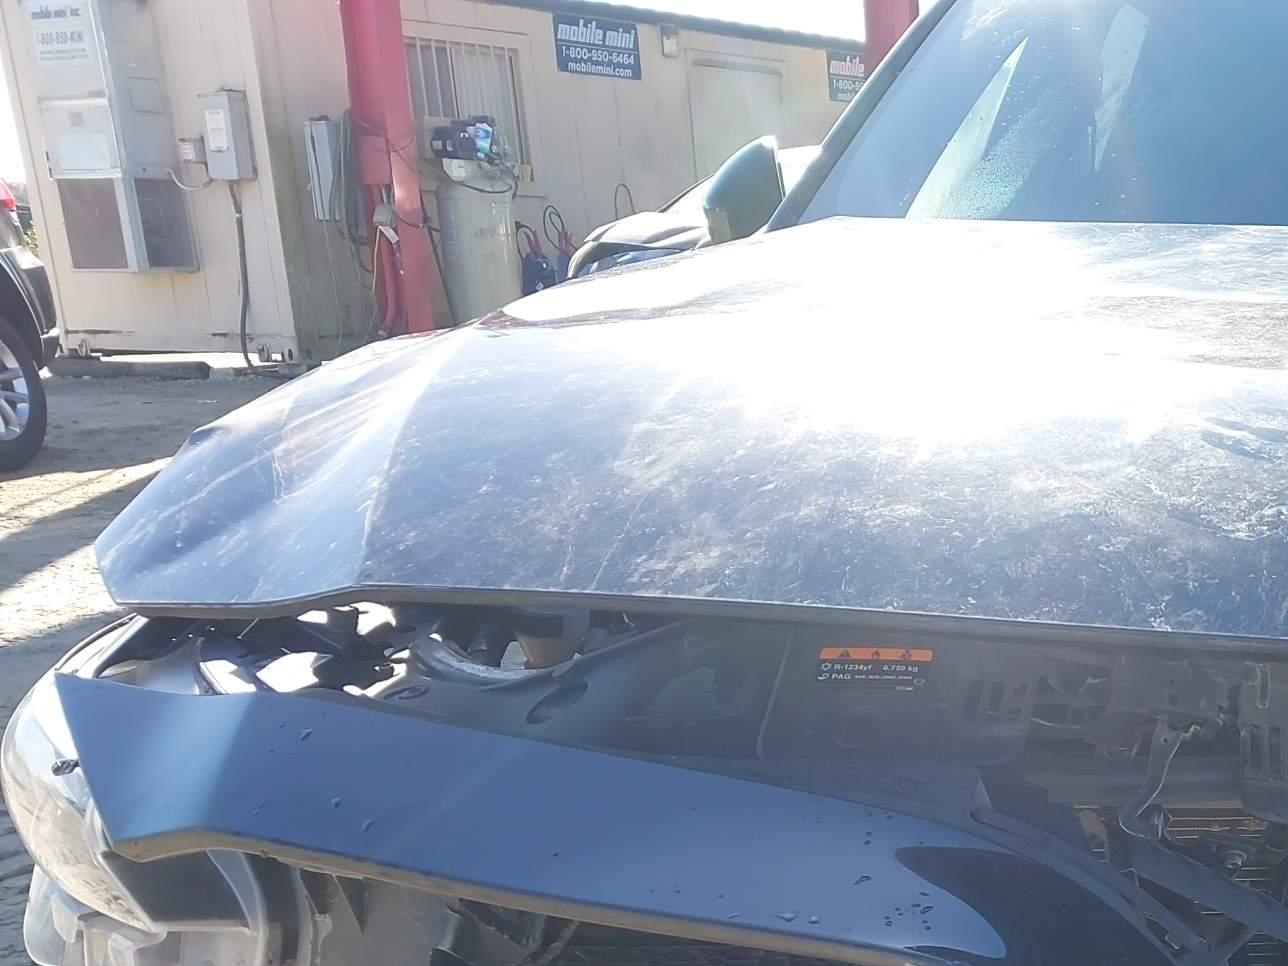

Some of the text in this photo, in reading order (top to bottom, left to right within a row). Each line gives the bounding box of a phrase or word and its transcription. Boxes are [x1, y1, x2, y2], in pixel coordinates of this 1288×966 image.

[557, 19, 636, 49] mobile mini
[561, 46, 635, 65] 1-800-950-6464
[567, 61, 633, 78] mobilemini.com
[829, 55, 865, 77] mobile
[833, 663, 919, 673] R-1234yf 0.750 kg
